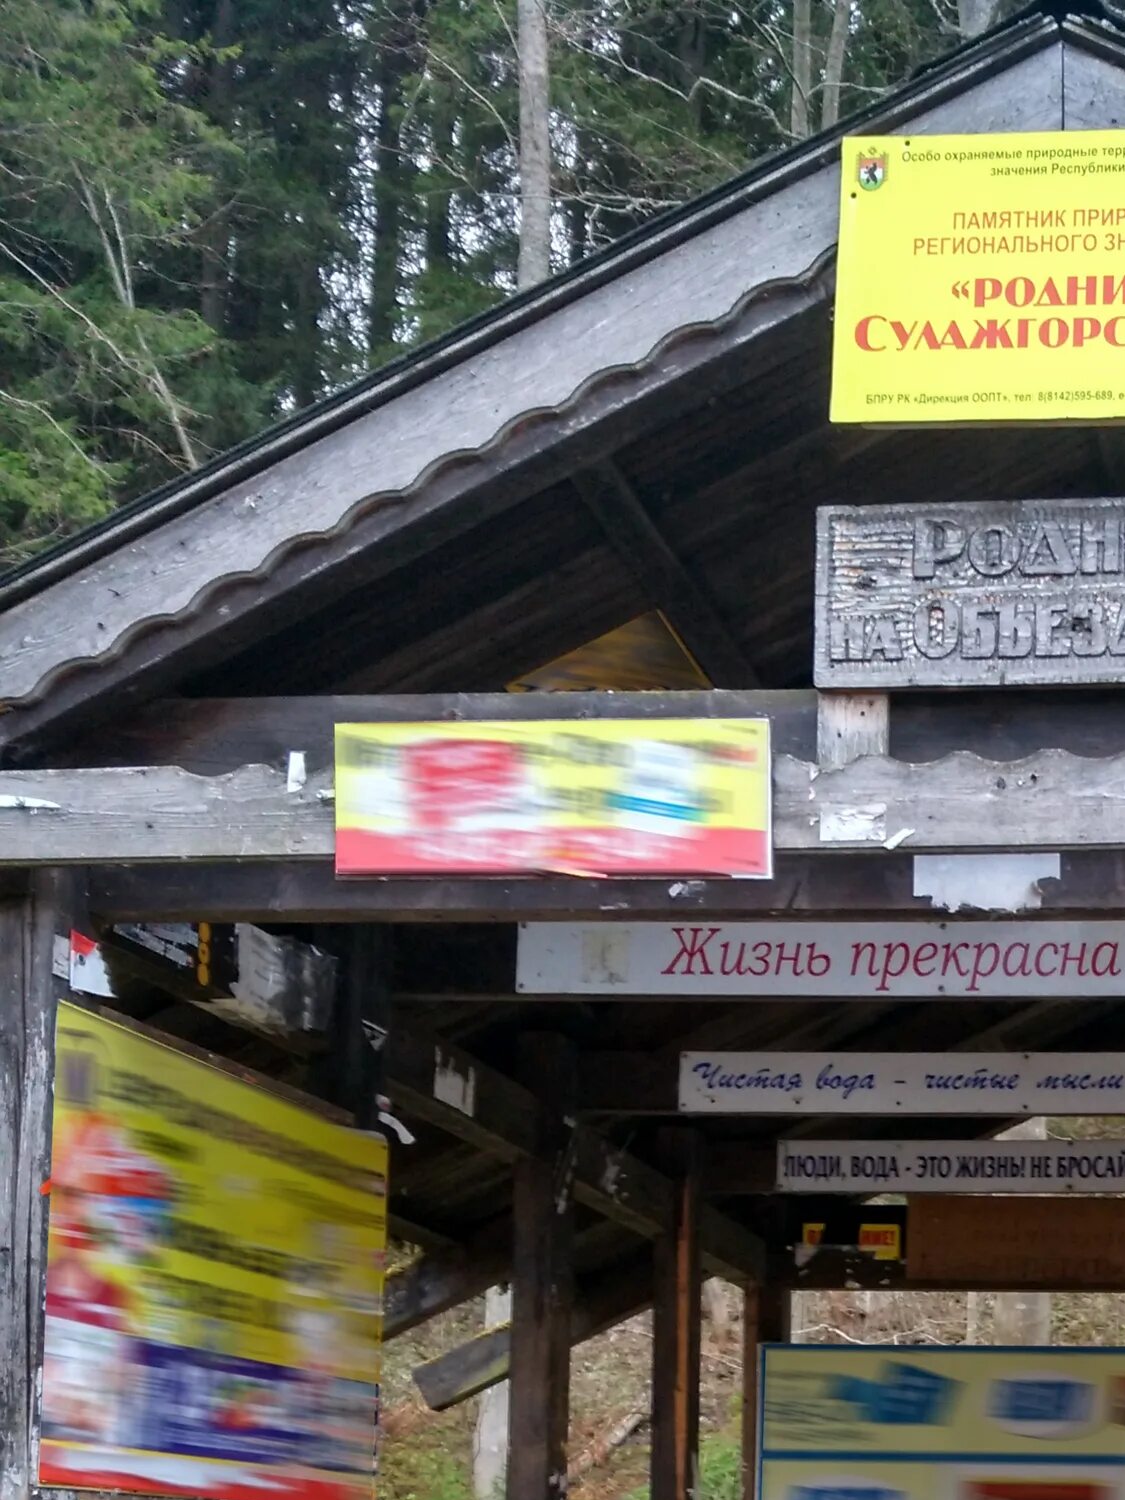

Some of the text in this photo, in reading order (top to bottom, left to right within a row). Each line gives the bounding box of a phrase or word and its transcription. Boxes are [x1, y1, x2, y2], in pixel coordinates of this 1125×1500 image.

[901, 150, 941, 163] Особо
[944, 149, 1023, 167] охраняемые
[1026, 146, 1098, 162] природные
[990, 165, 1048, 176] значения
[1051, 161, 1125, 177] Республики
[952, 210, 1066, 231] ПАМЯТНИК
[913, 234, 1097, 256] РЕГИОНАЛЬНОГО
[831, 615, 902, 662] НА
[660, 926, 832, 977] Жизнь
[849, 939, 1122, 990] прекрасна
[692, 1062, 803, 1090] Чистая
[815, 1064, 875, 1100] вода
[924, 1069, 1020, 1091] чистые
[1036, 1070, 1124, 1090] мысли
[784, 1155, 846, 1182] ЛЮДИ,
[850, 1155, 899, 1179] ВОДА
[916, 1154, 950, 1178] ЭТО
[955, 1154, 1025, 1179] ЖИЗНЬ!
[1030, 1155, 1053, 1178] НЕ
